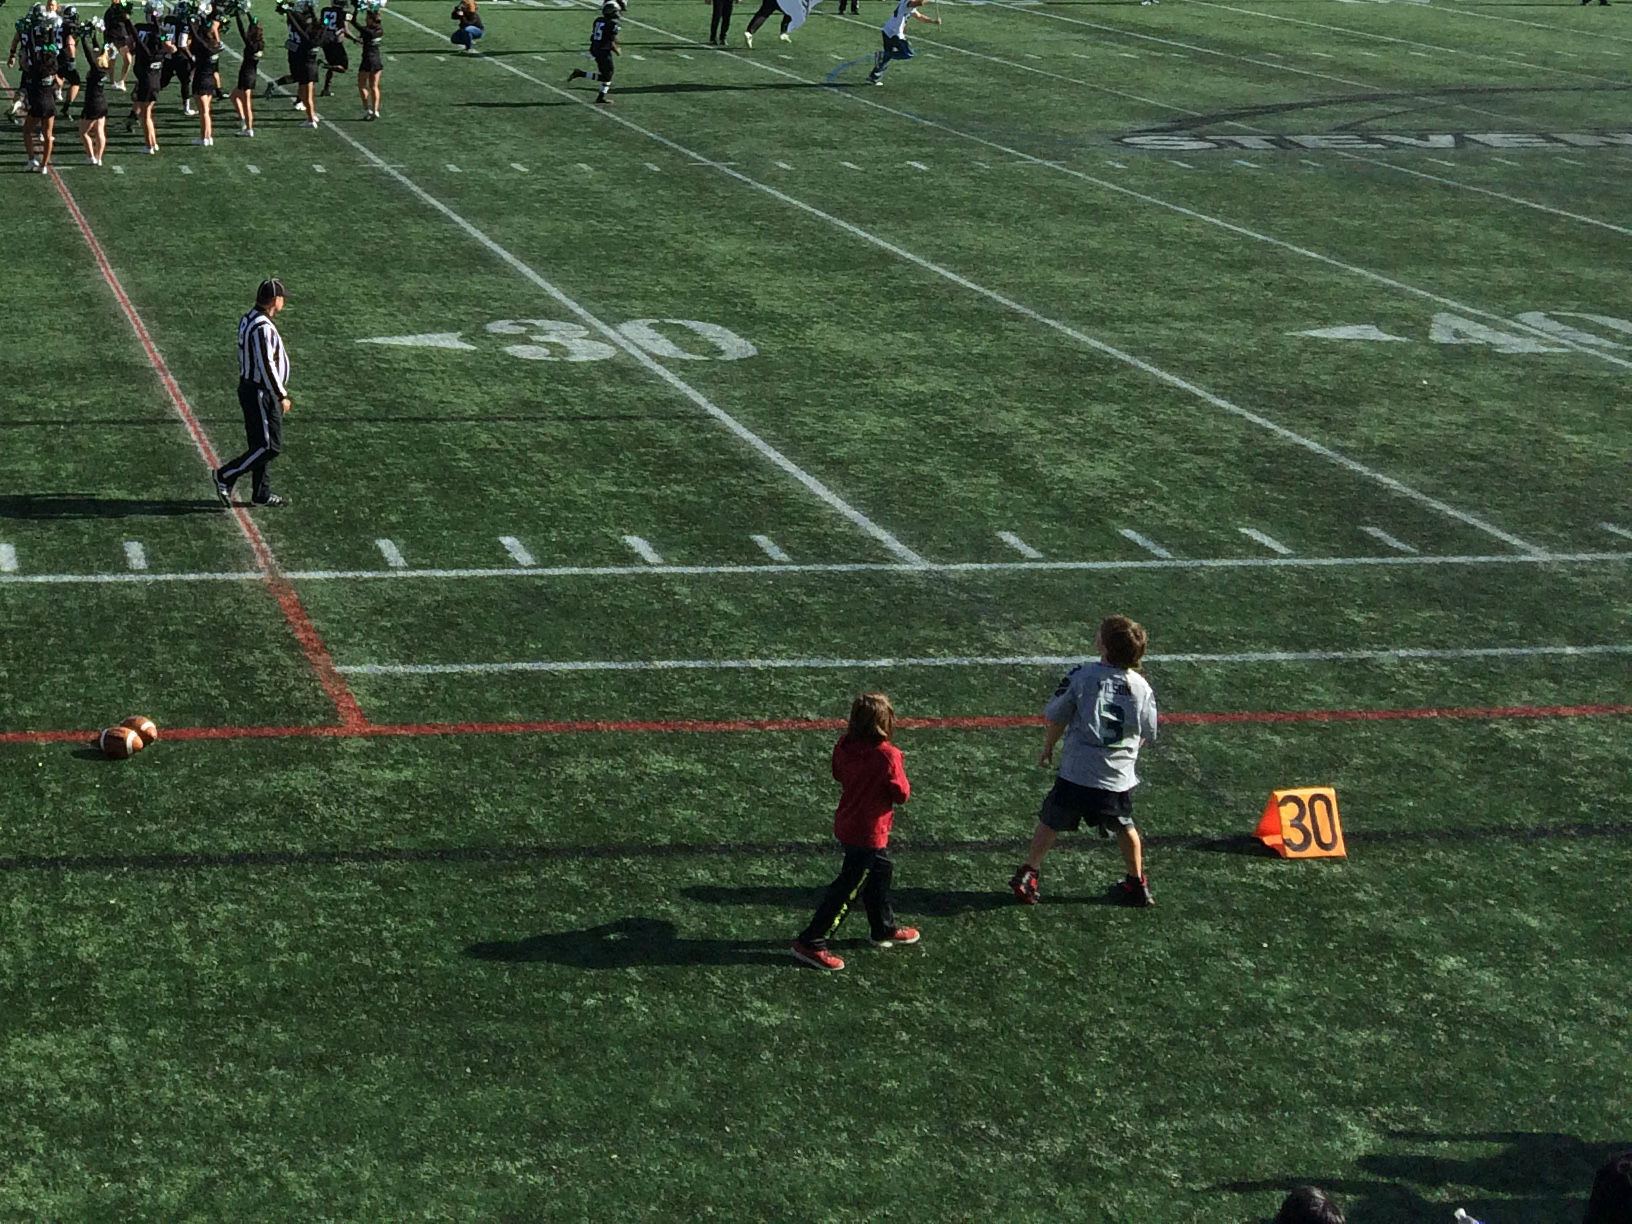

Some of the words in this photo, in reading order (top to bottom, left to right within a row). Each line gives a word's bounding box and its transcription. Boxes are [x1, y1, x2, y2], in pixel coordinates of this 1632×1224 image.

[484, 318, 759, 363] 30
[1098, 701, 1126, 747] 3
[1278, 794, 1339, 853] 30
